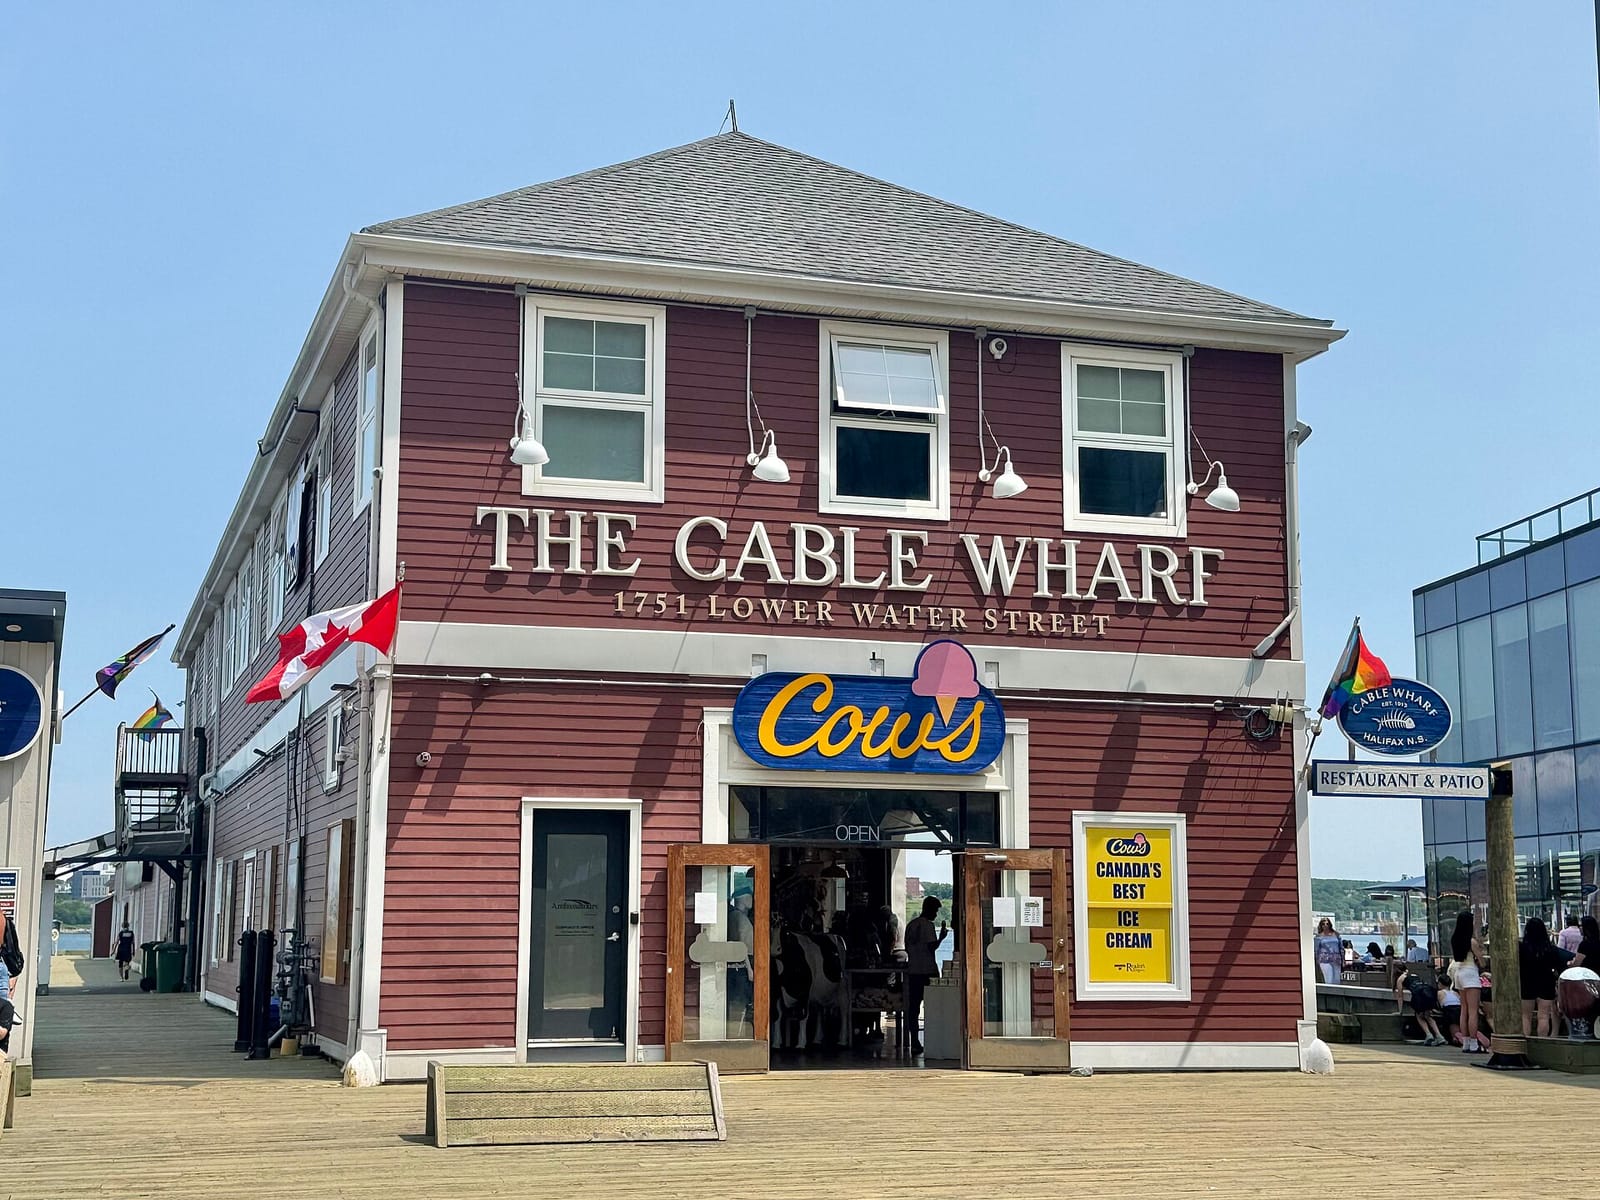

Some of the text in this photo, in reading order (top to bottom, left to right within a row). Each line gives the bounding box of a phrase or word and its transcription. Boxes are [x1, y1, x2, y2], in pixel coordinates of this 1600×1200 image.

[476, 506, 1225, 607] THE CABLE WHARF
[613, 591, 1110, 635] 1751 LOWER WATER STREET
[1352, 687, 1438, 717] CABLE WHARF
[1363, 732, 1428, 746] HALIFAX N.S.
[1320, 771, 1484, 789] RESTAURANT & PATIO
[835, 824, 880, 842] OPEN
[1096, 861, 1162, 878] CANADA'S
[1113, 883, 1146, 900] BEST
[1117, 910, 1139, 927] ICE
[1106, 932, 1152, 948] CREAM
